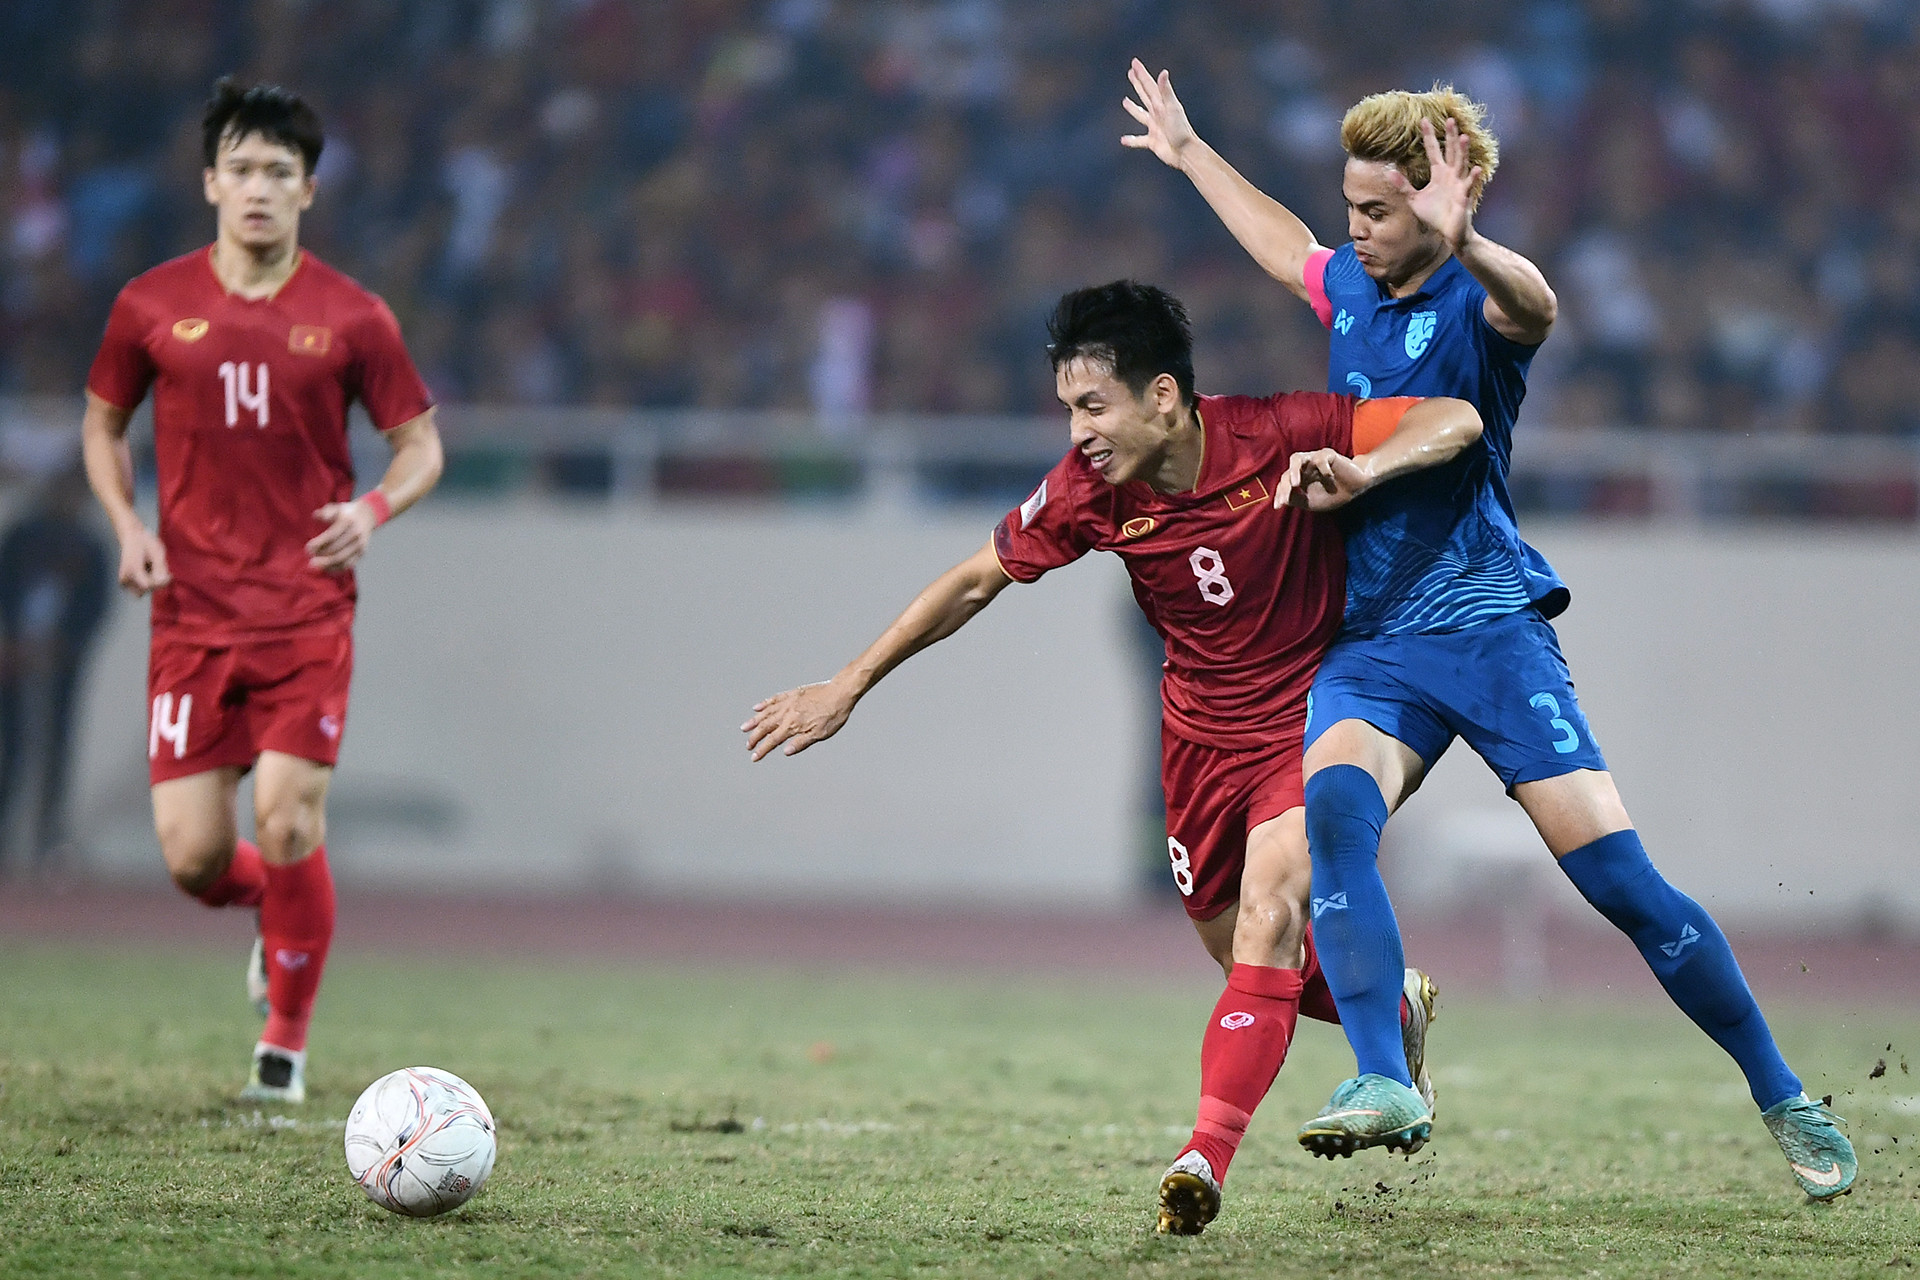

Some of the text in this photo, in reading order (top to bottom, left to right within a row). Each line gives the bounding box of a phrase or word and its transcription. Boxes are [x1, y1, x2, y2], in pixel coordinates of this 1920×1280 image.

[218, 360, 270, 429] 14
[1189, 546, 1235, 606] 8
[149, 691, 193, 760] 14
[1529, 692, 1579, 753] 3
[1167, 835, 1194, 896] 8
